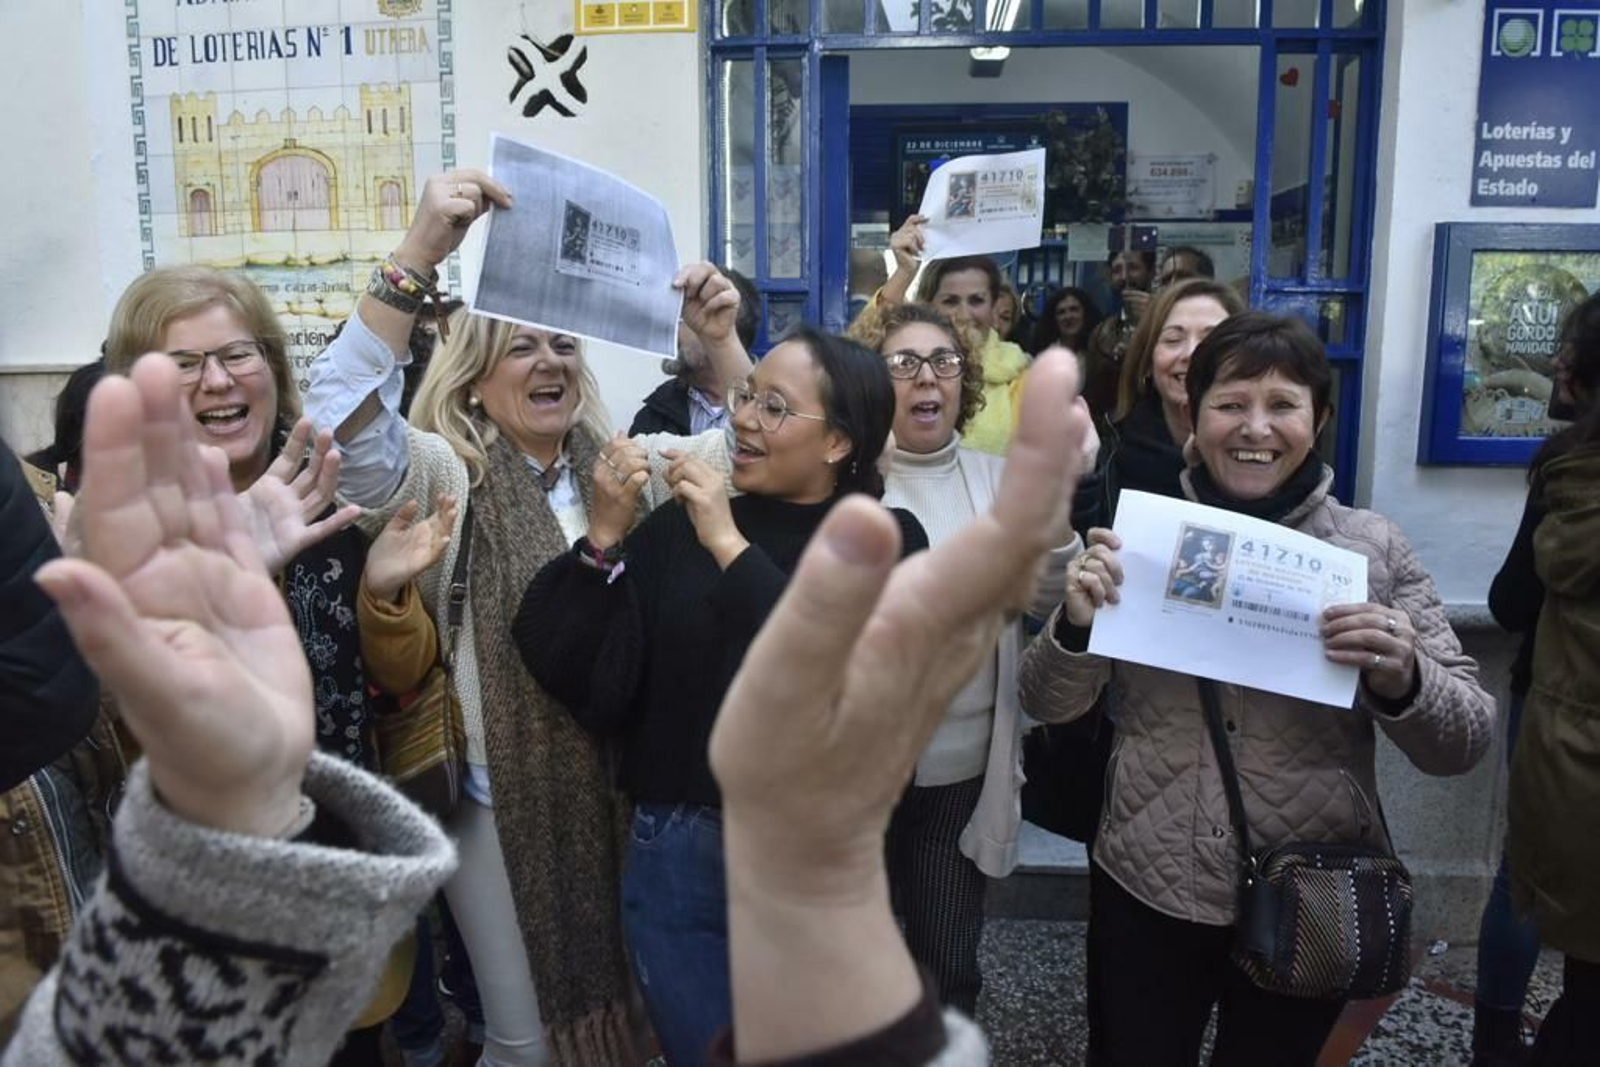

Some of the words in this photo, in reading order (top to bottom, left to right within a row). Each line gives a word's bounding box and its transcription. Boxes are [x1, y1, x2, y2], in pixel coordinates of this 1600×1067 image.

[153, 36, 179, 67] DE
[190, 28, 298, 64] LOTERIAS
[339, 26, 354, 56] 1
[364, 26, 431, 56] UTRERA
[1482, 121, 1556, 140] Loterías
[1559, 126, 1572, 145] y
[1478, 150, 1563, 172] Apuestas
[1567, 150, 1596, 169] del
[980, 168, 1024, 183] 41710
[1477, 178, 1539, 196] Estado
[591, 220, 628, 241] 41710
[1507, 325, 1556, 341] GORDO
[1240, 539, 1323, 575] 41710
